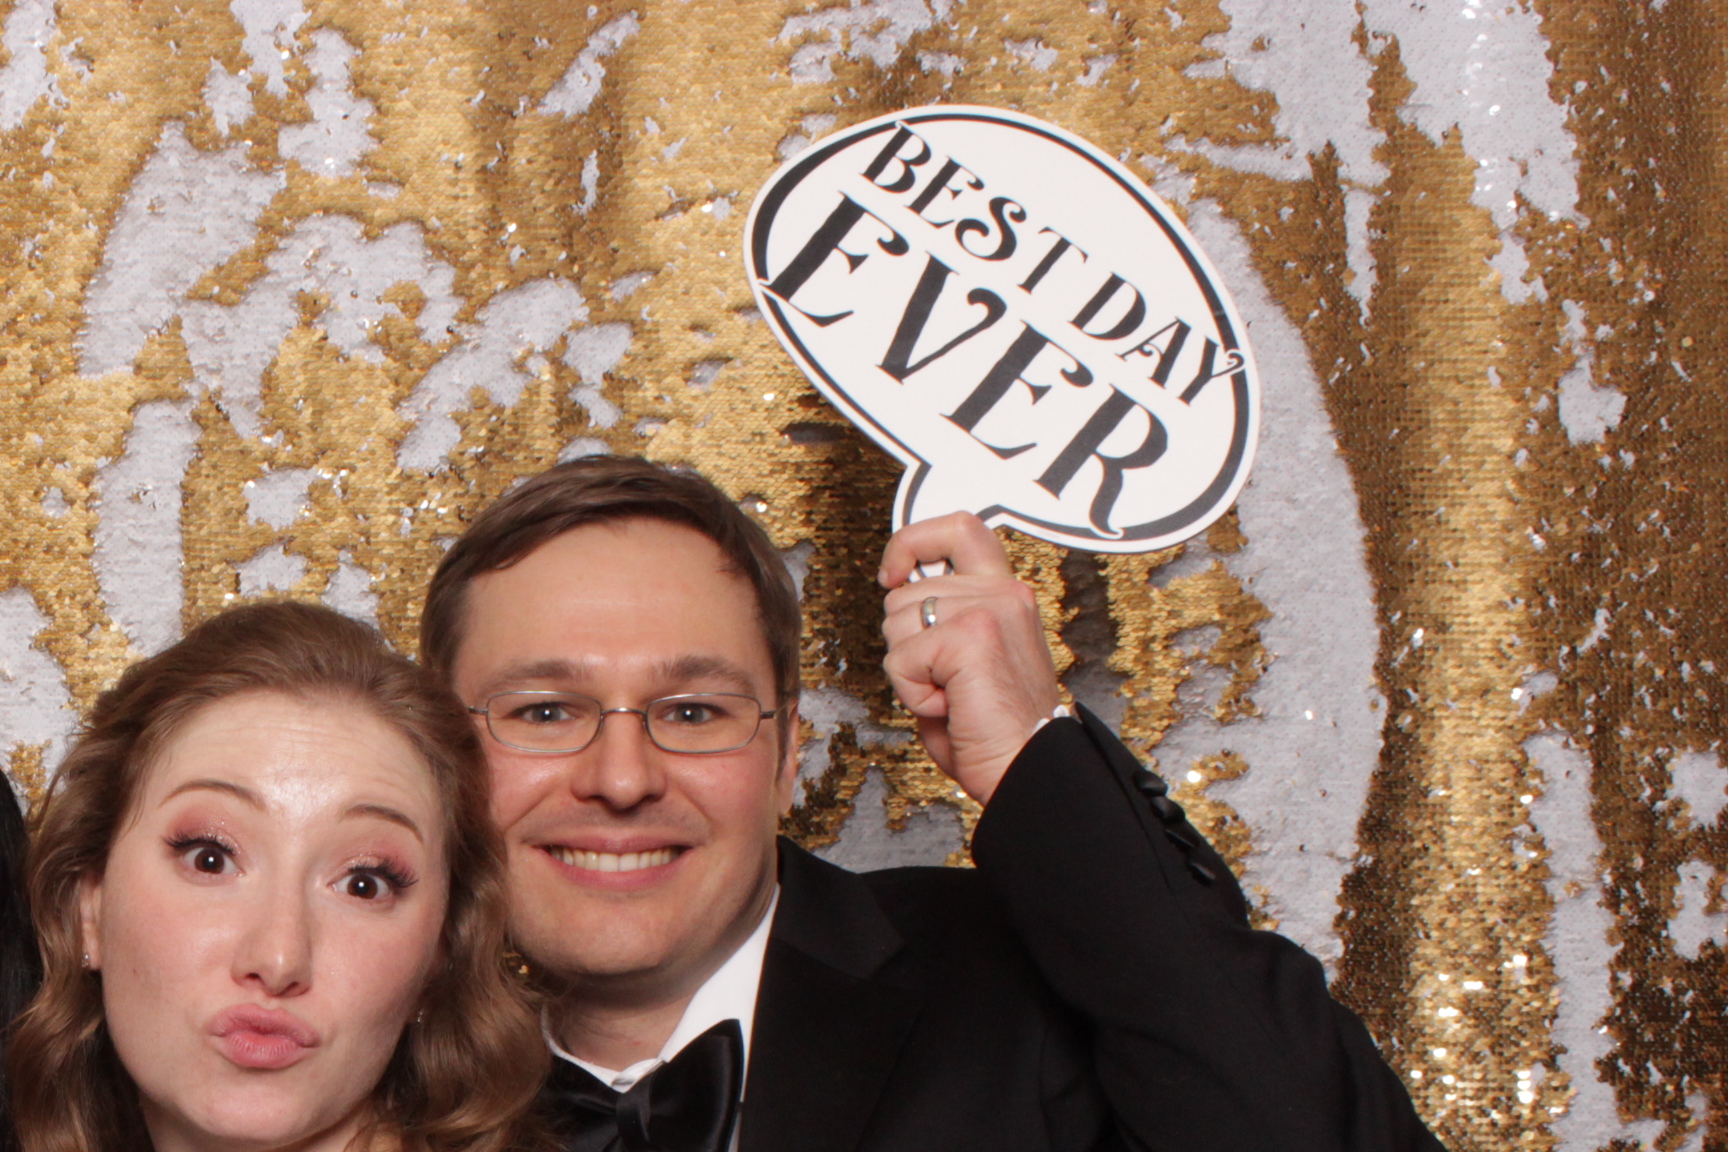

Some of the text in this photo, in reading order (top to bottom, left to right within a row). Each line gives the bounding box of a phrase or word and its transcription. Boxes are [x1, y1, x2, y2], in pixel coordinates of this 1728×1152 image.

[762, 190, 1168, 535] EVER
[859, 122, 1245, 406] BEST DAY
